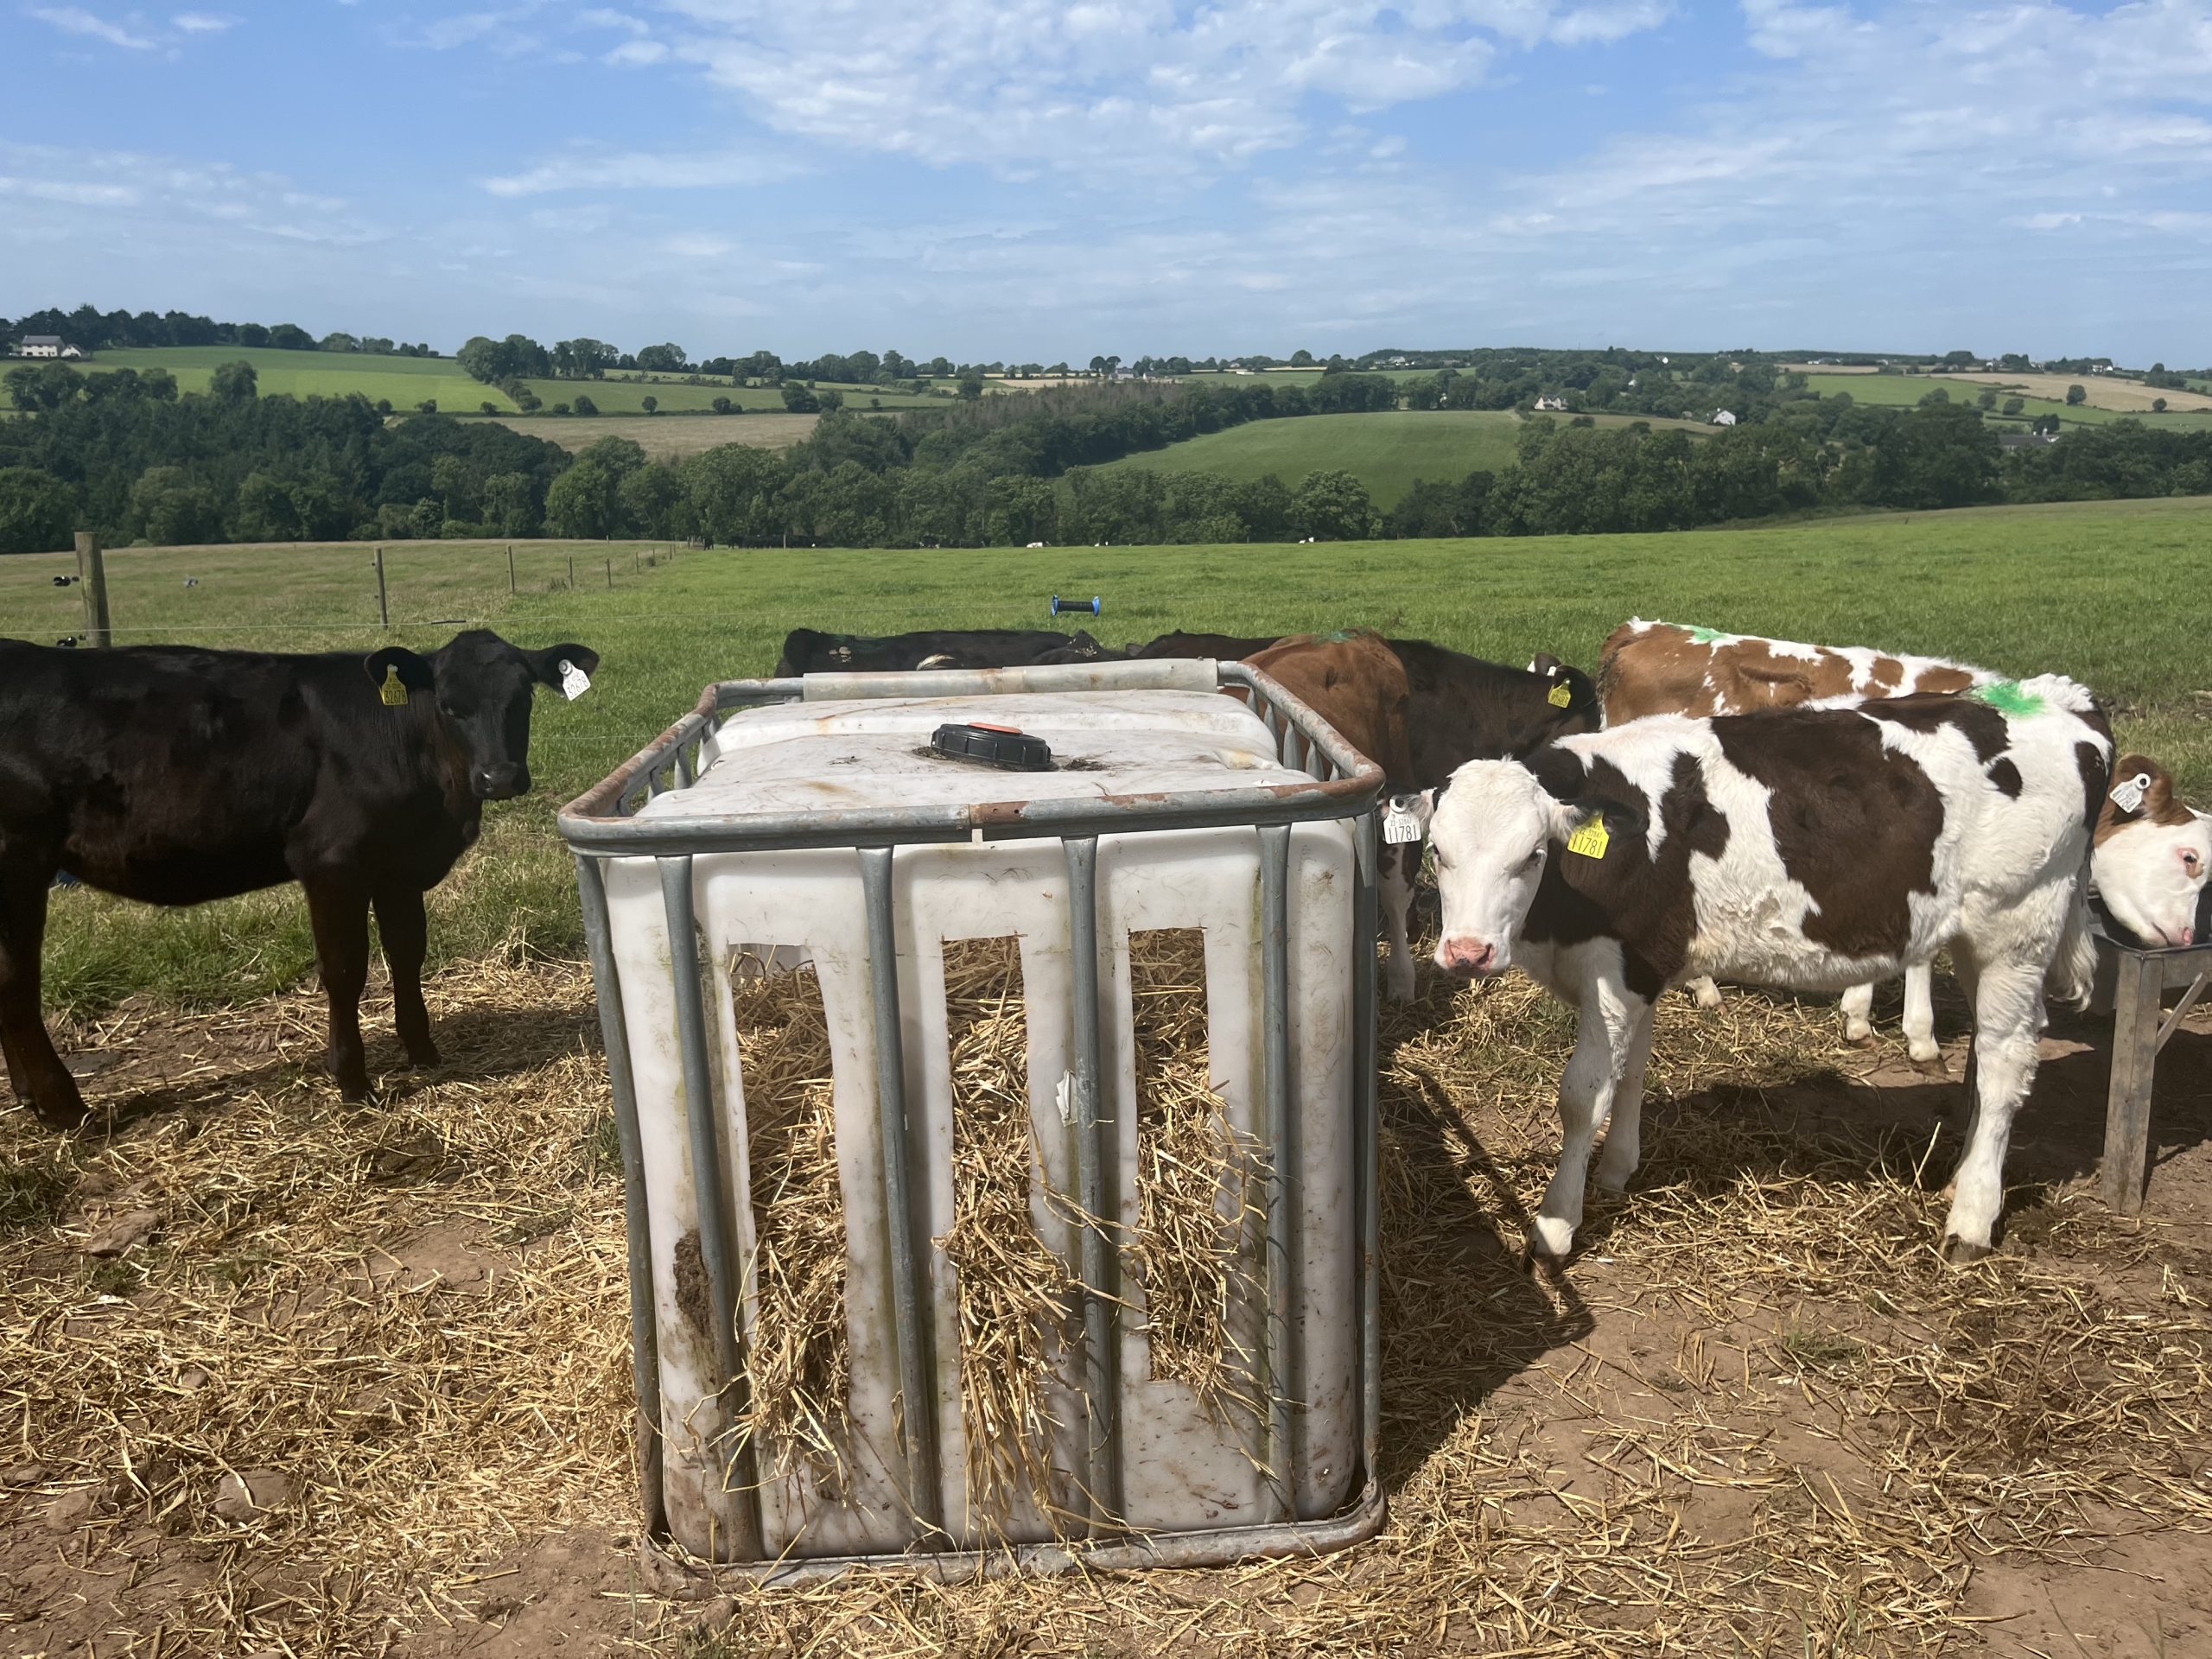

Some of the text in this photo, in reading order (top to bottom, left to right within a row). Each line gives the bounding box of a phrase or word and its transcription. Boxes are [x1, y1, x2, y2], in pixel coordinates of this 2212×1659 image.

[385, 690, 407, 704] 32678
[1389, 824, 1417, 843] 11781
[1572, 834, 1602, 856] 11781
